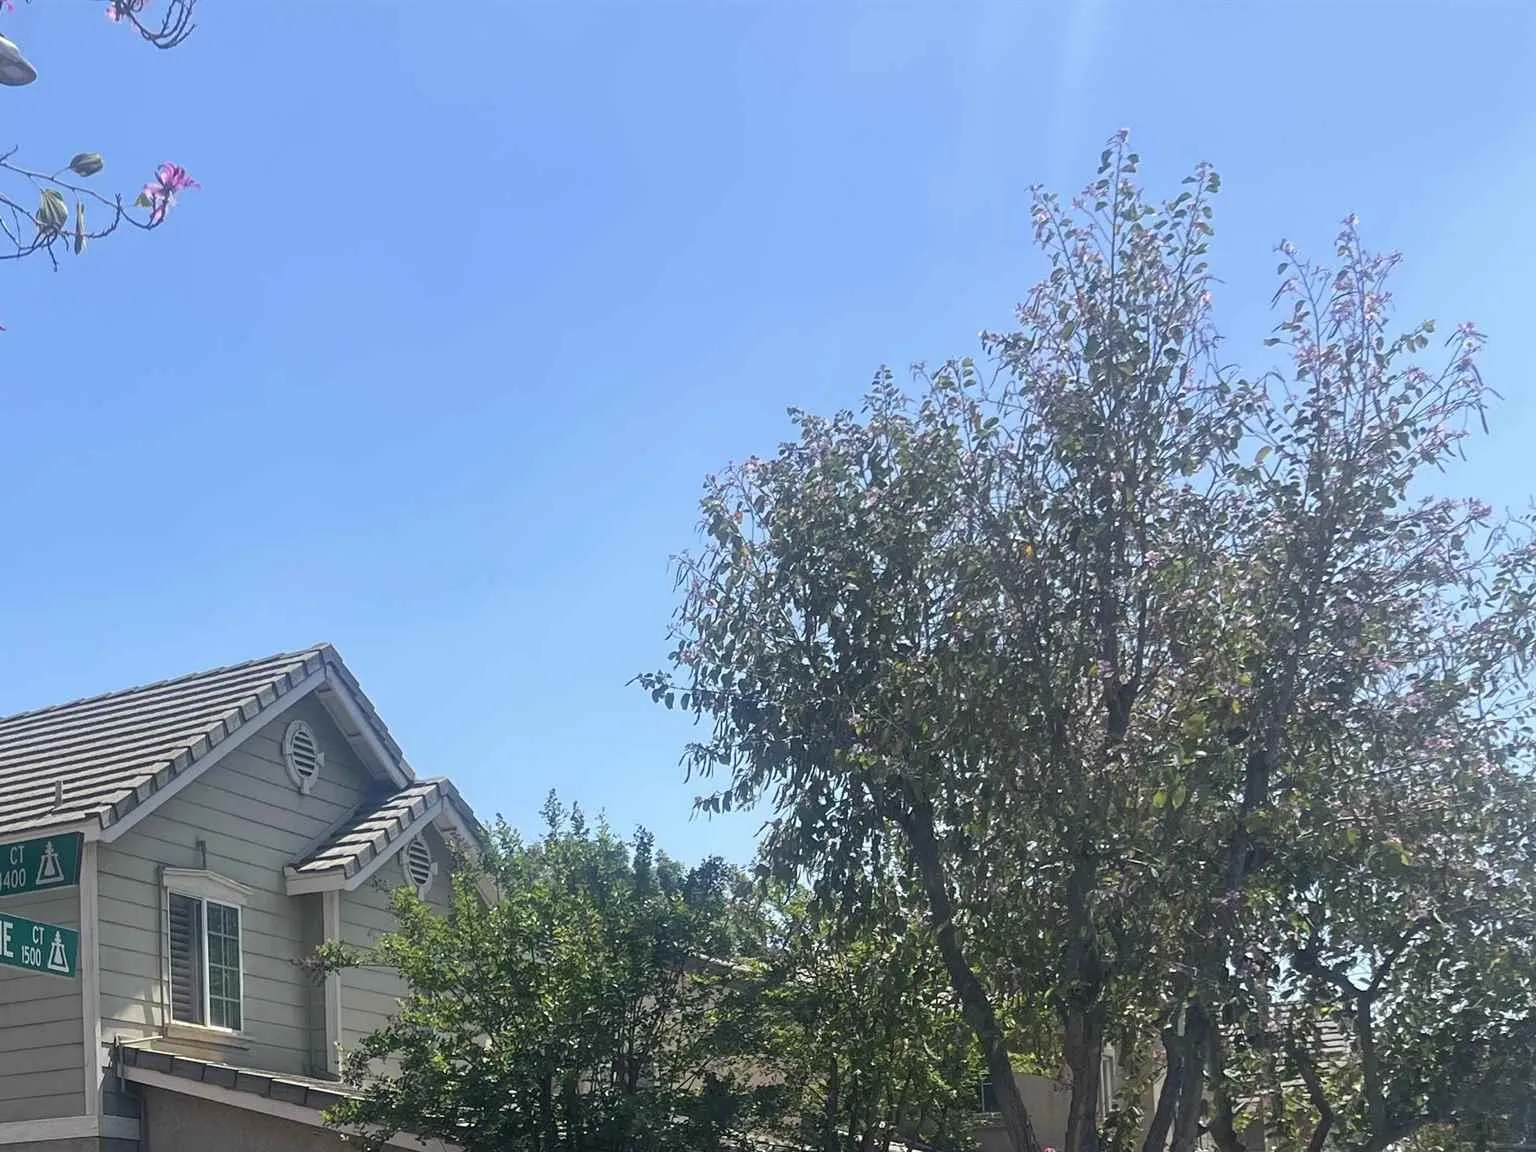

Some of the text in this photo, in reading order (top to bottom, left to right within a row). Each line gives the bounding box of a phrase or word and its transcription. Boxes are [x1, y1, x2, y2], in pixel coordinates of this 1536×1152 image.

[9, 845, 25, 865] CT
[32, 926, 44, 945] CT
[21, 945, 42, 967] 1500
